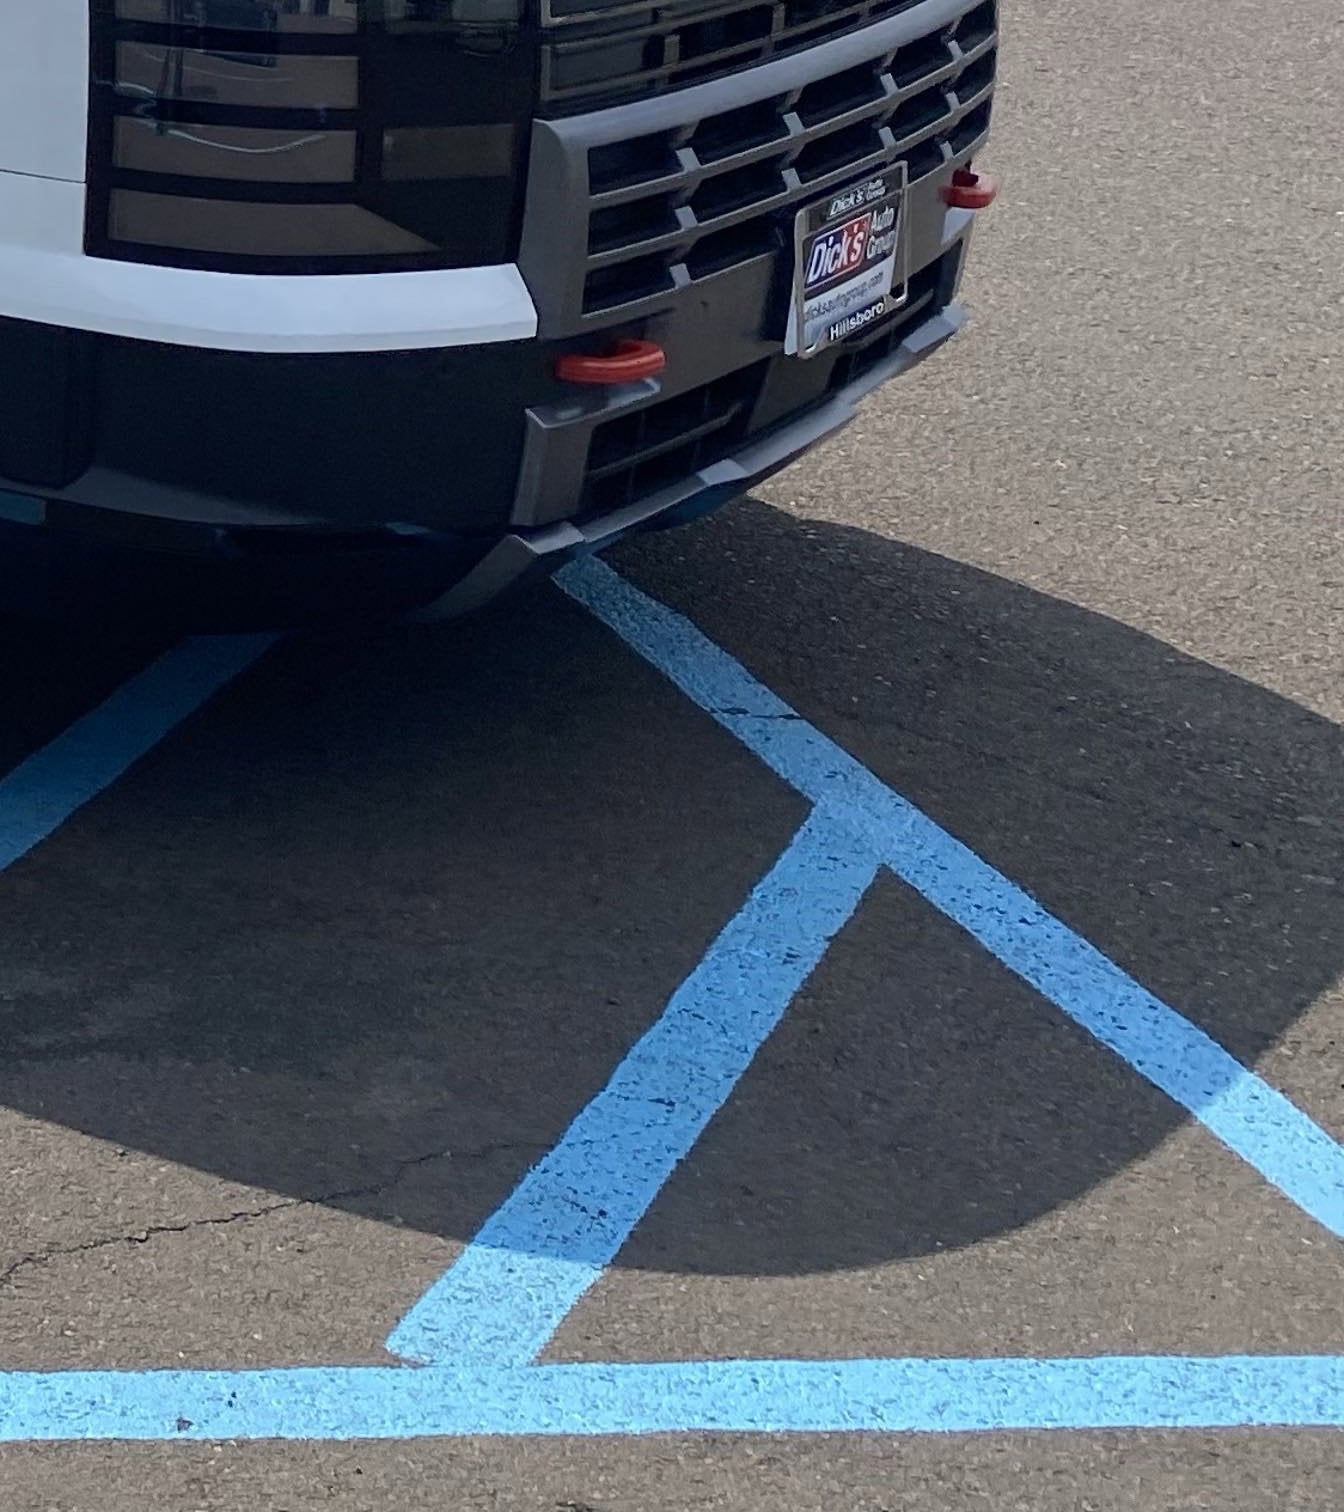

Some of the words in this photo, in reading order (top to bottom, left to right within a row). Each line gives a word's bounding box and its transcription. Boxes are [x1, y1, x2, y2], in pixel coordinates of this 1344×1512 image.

[807, 223, 865, 284] Dick's
[872, 205, 895, 232] Auto
[830, 302, 884, 341] Hillsboro
